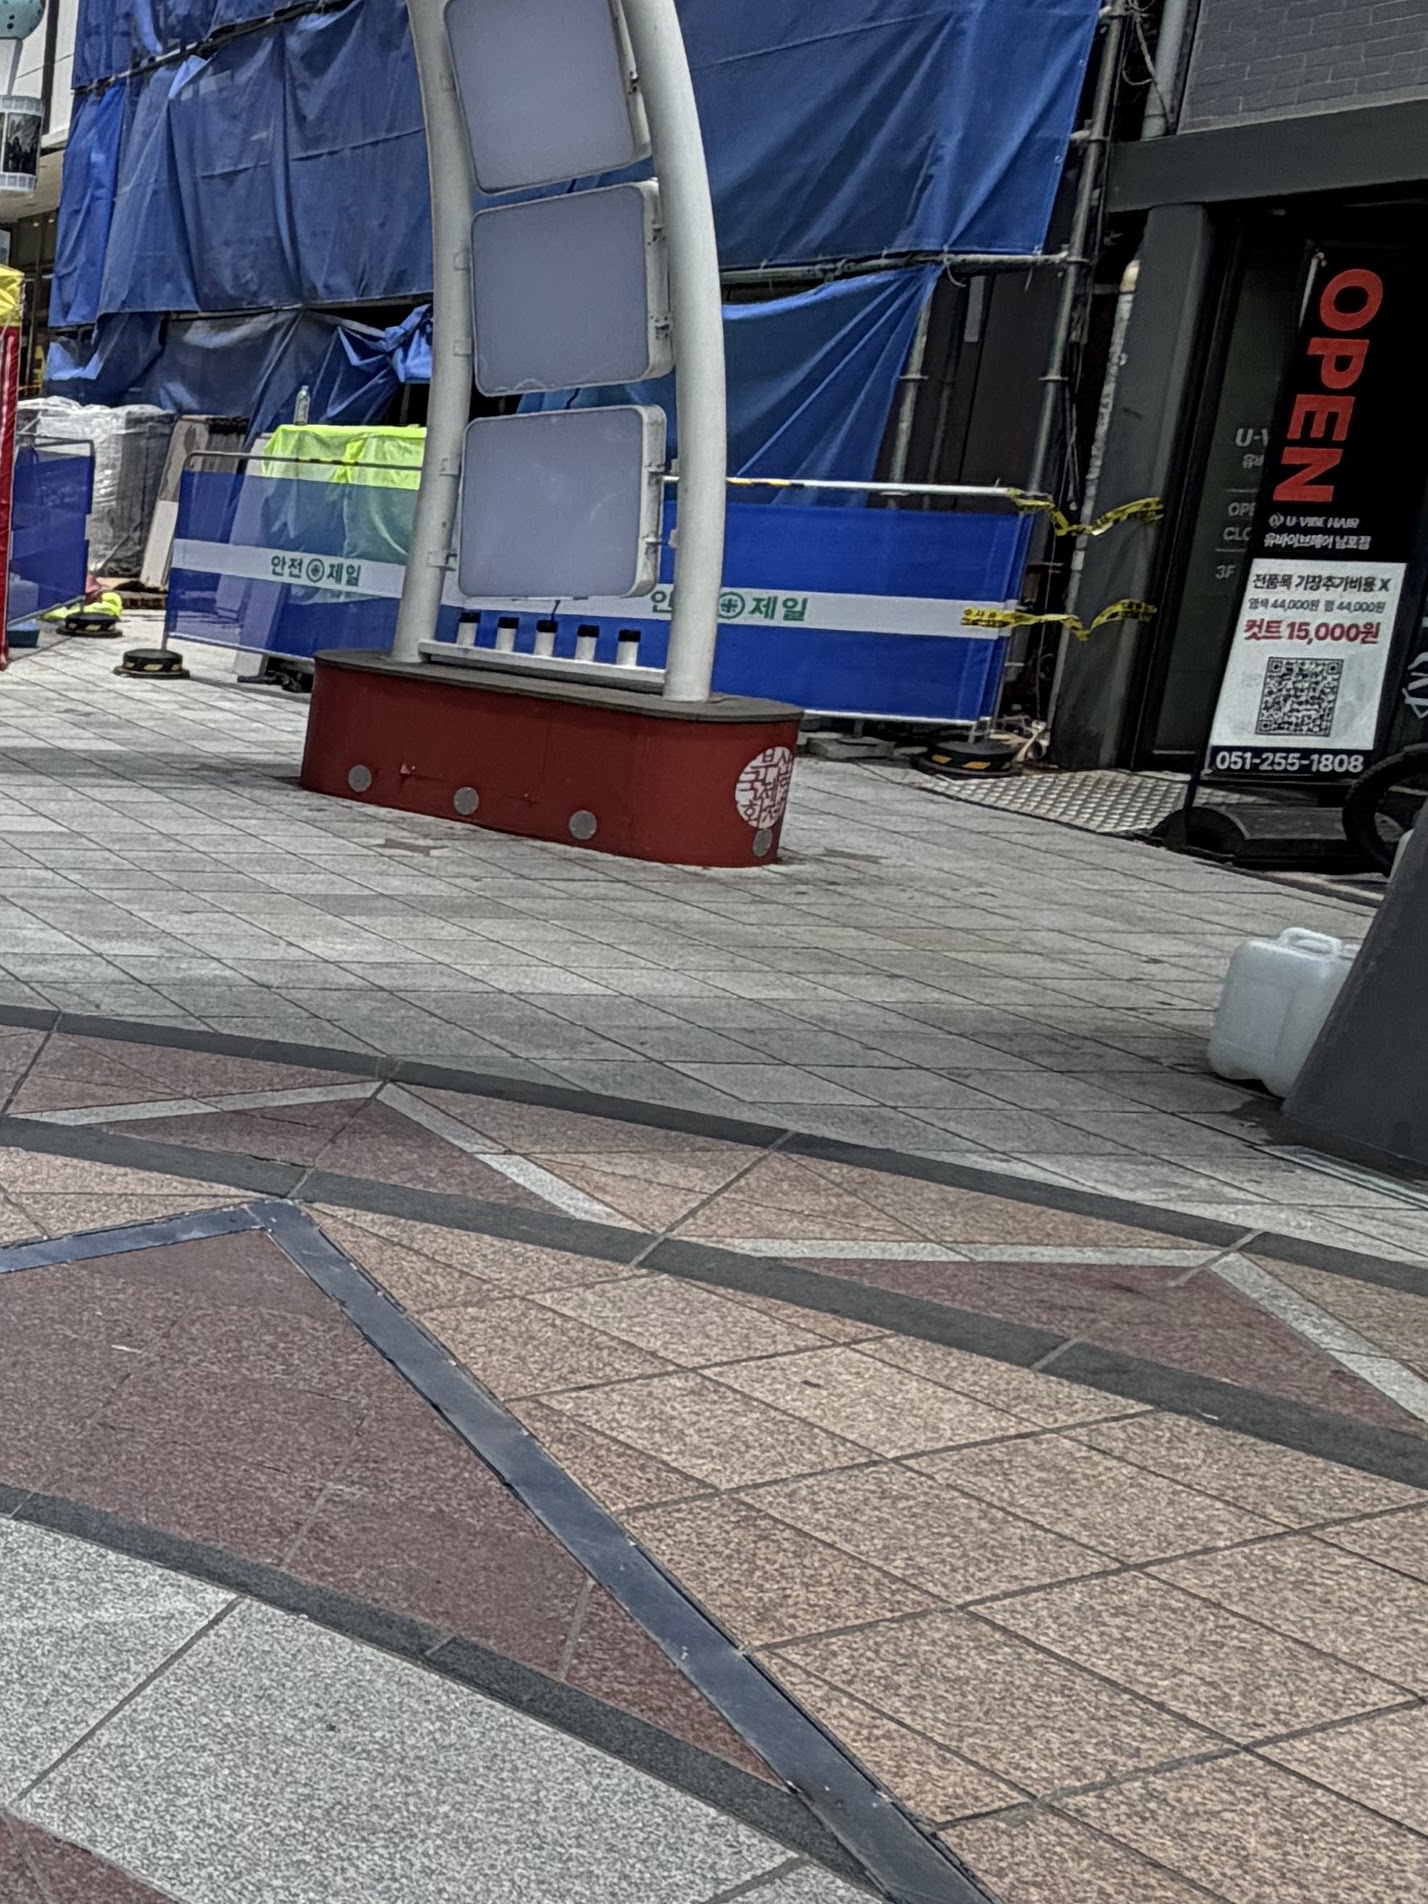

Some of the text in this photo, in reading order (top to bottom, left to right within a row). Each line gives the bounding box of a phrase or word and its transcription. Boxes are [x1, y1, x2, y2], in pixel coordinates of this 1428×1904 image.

[1272, 268, 1384, 503] OPEN
[1327, 516, 1360, 529] HAIR
[271, 555, 362, 587] 안전 제일
[1252, 572, 1293, 592] 전품목
[1378, 577, 1392, 593] X
[747, 596, 808, 622] 제일
[1270, 598, 1319, 613] 44,000원
[1336, 600, 1387, 614] 44,000원
[1285, 621, 1382, 645] 15,000원
[1215, 751, 1365, 773] 051-255-1808
